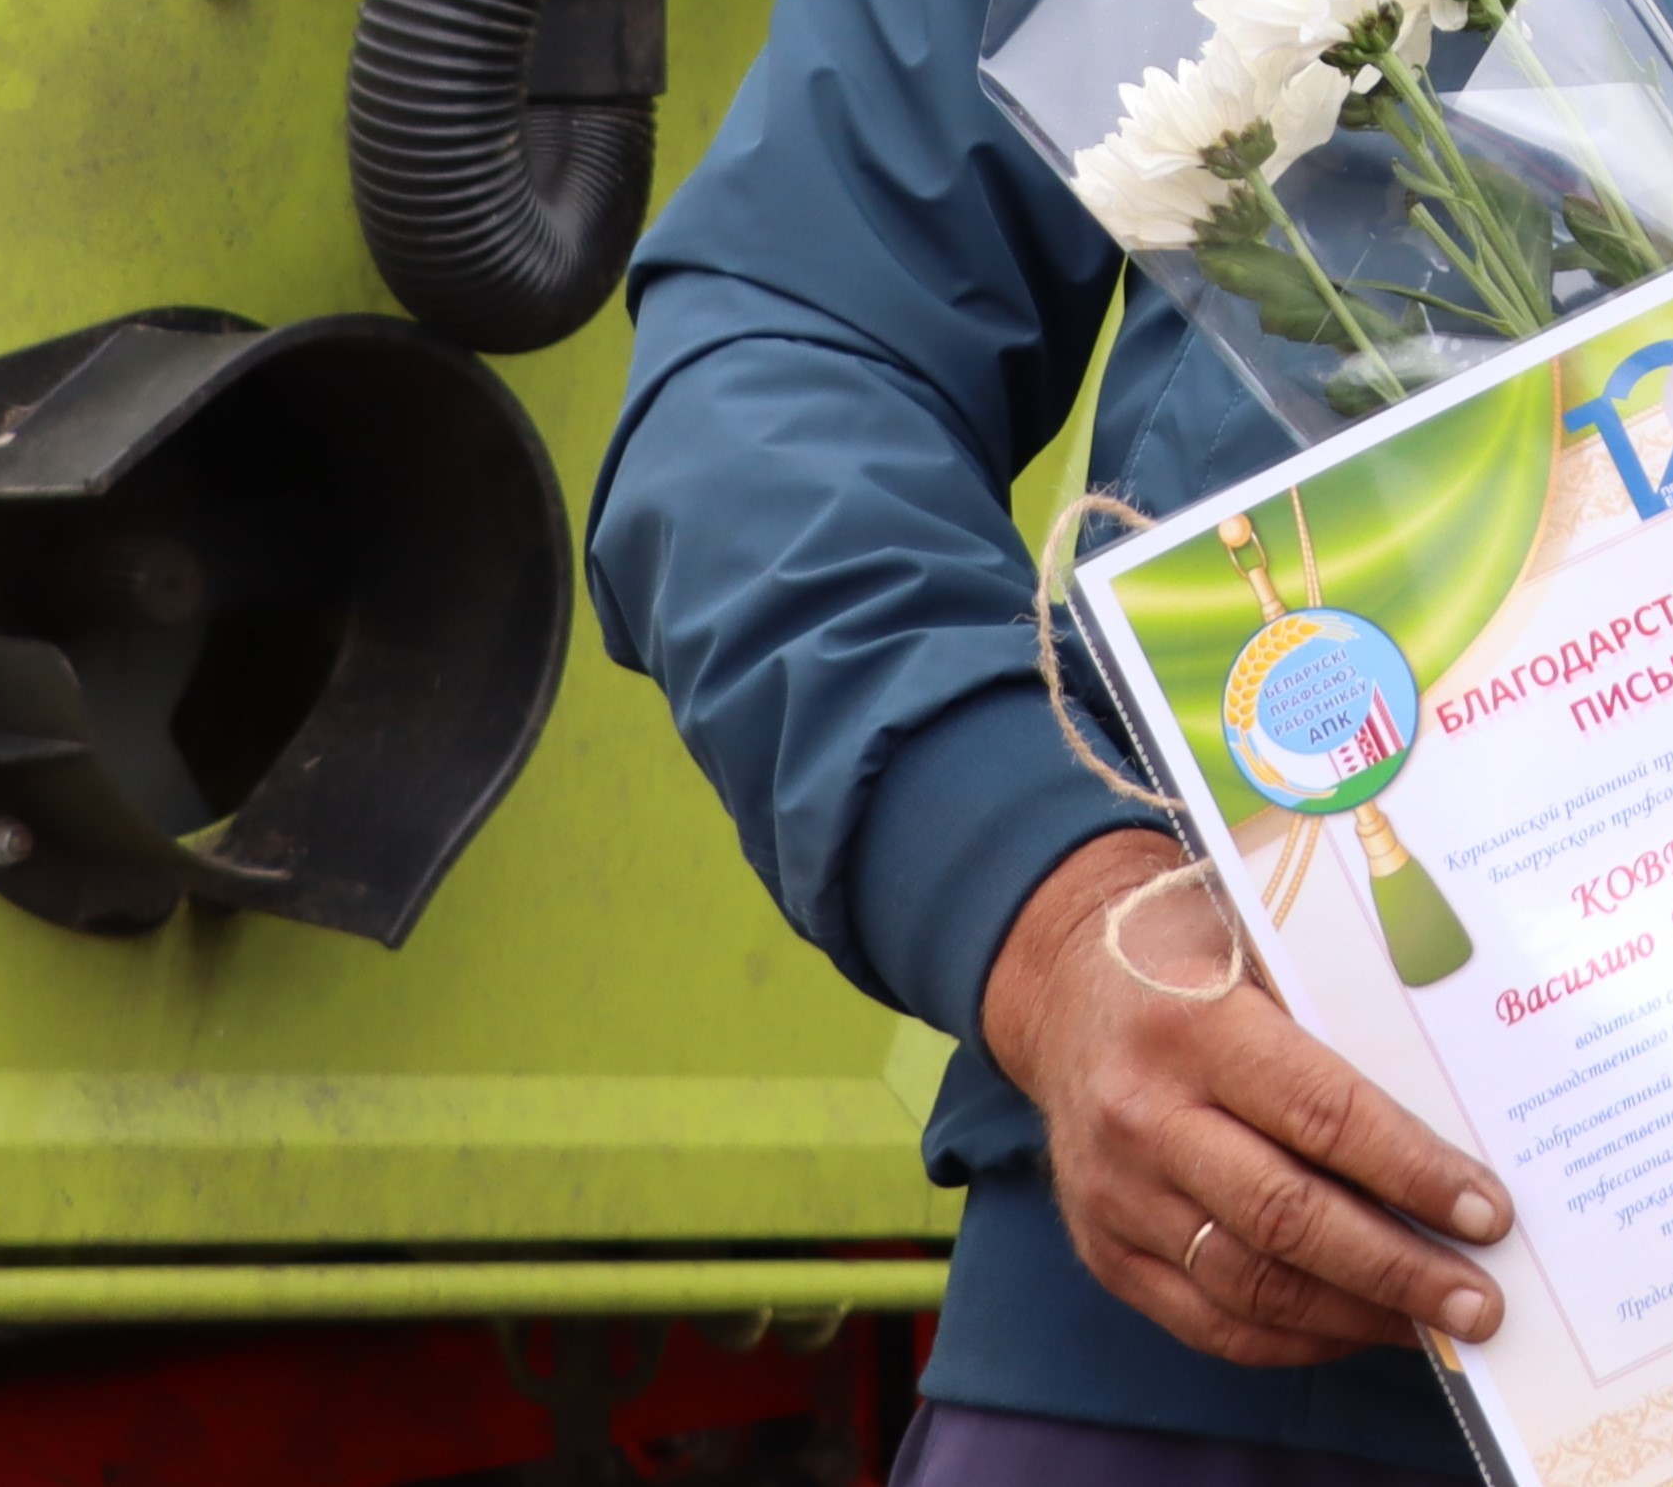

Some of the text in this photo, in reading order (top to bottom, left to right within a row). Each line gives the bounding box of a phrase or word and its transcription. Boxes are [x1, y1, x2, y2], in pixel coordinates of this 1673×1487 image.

[1262, 648, 1347, 700] БЕЛАРУСКІ
[1268, 664, 1358, 717] ПРАФСАЮЗ
[1306, 709, 1353, 745] АПК
[1442, 803, 1561, 872] Кореличской
[1562, 760, 1649, 821] районной
[1487, 818, 1606, 885] Белорусского
[1494, 932, 1655, 1027] Василию
[1574, 996, 1662, 1050] водителю
[1506, 1029, 1668, 1123] производственного
[1513, 1147, 1533, 1168] за
[1534, 1073, 1673, 1156] добросовестный
